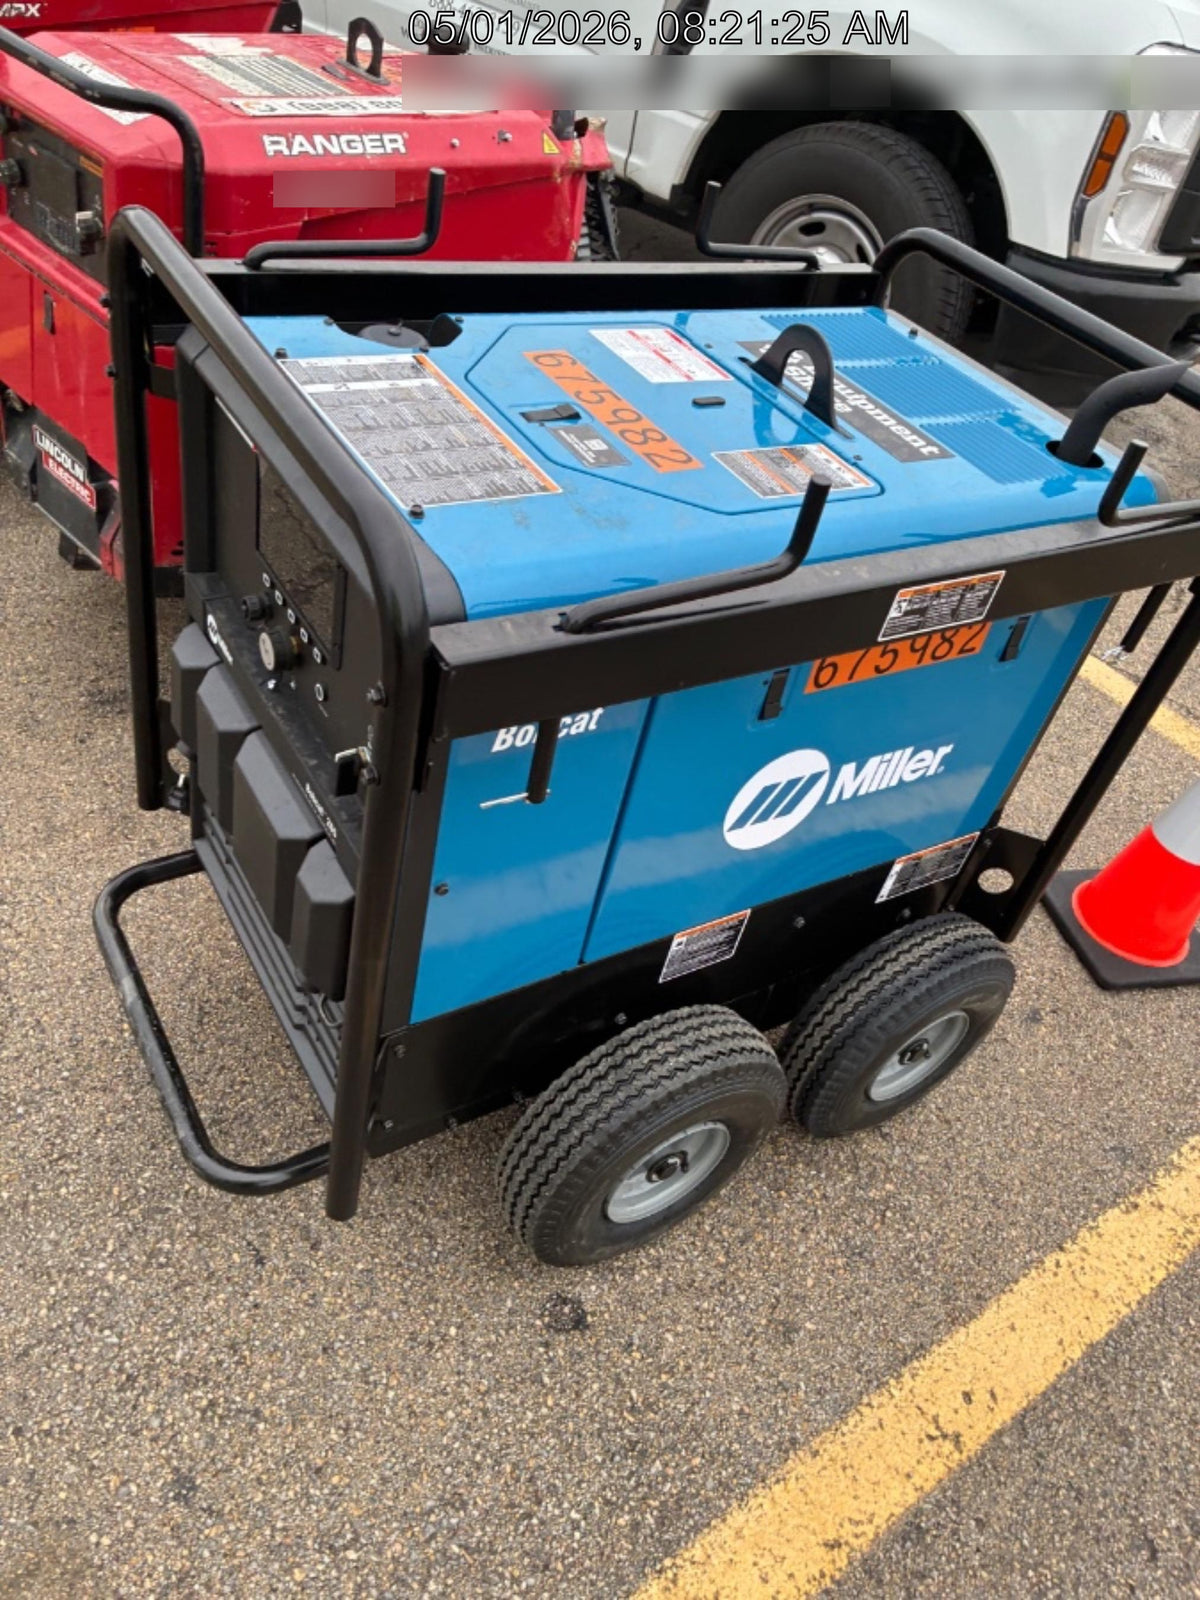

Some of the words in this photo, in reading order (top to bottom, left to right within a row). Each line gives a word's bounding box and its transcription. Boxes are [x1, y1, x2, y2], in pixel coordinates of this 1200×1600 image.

[262, 133, 405, 156] RANGER
[533, 352, 694, 469] 675982
[36, 430, 85, 483] LINCOLN
[491, 706, 605, 753] Bocat
[826, 743, 954, 805] Miller
